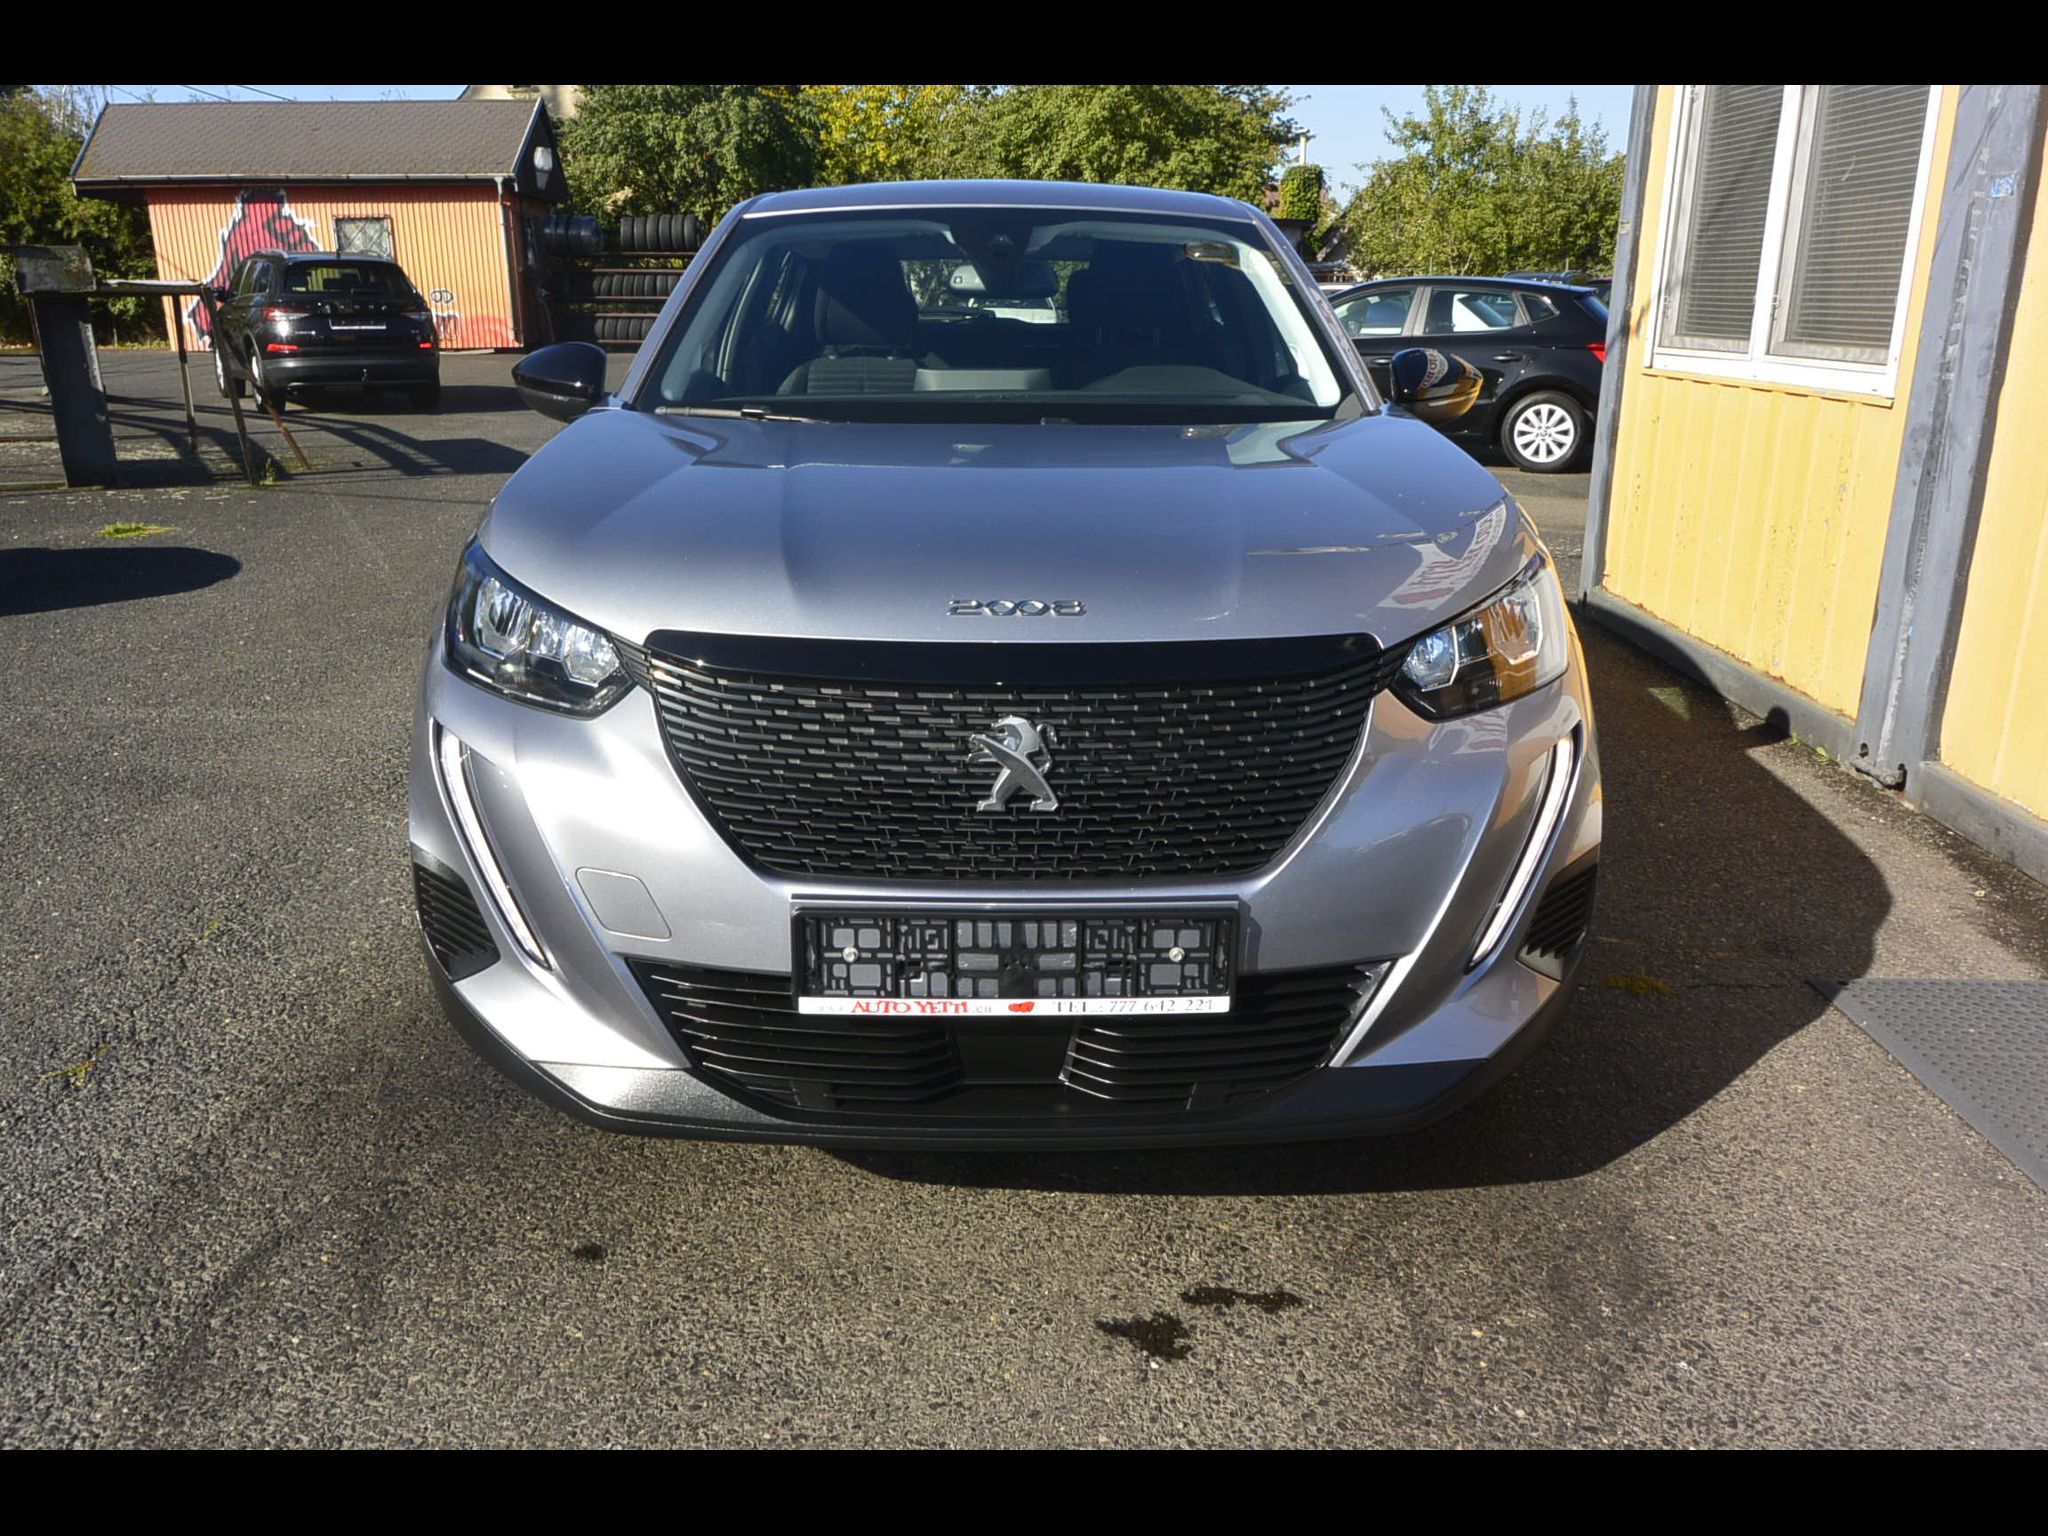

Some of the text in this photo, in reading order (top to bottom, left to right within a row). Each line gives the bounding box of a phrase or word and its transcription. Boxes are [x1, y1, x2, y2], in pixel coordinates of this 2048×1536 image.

[946, 599, 1087, 616] 2008
[850, 1000, 911, 1014] AUTO
[1109, 999, 1137, 1012] 777
[1143, 999, 1176, 1011] 642
[1185, 998, 1213, 1010] 221
